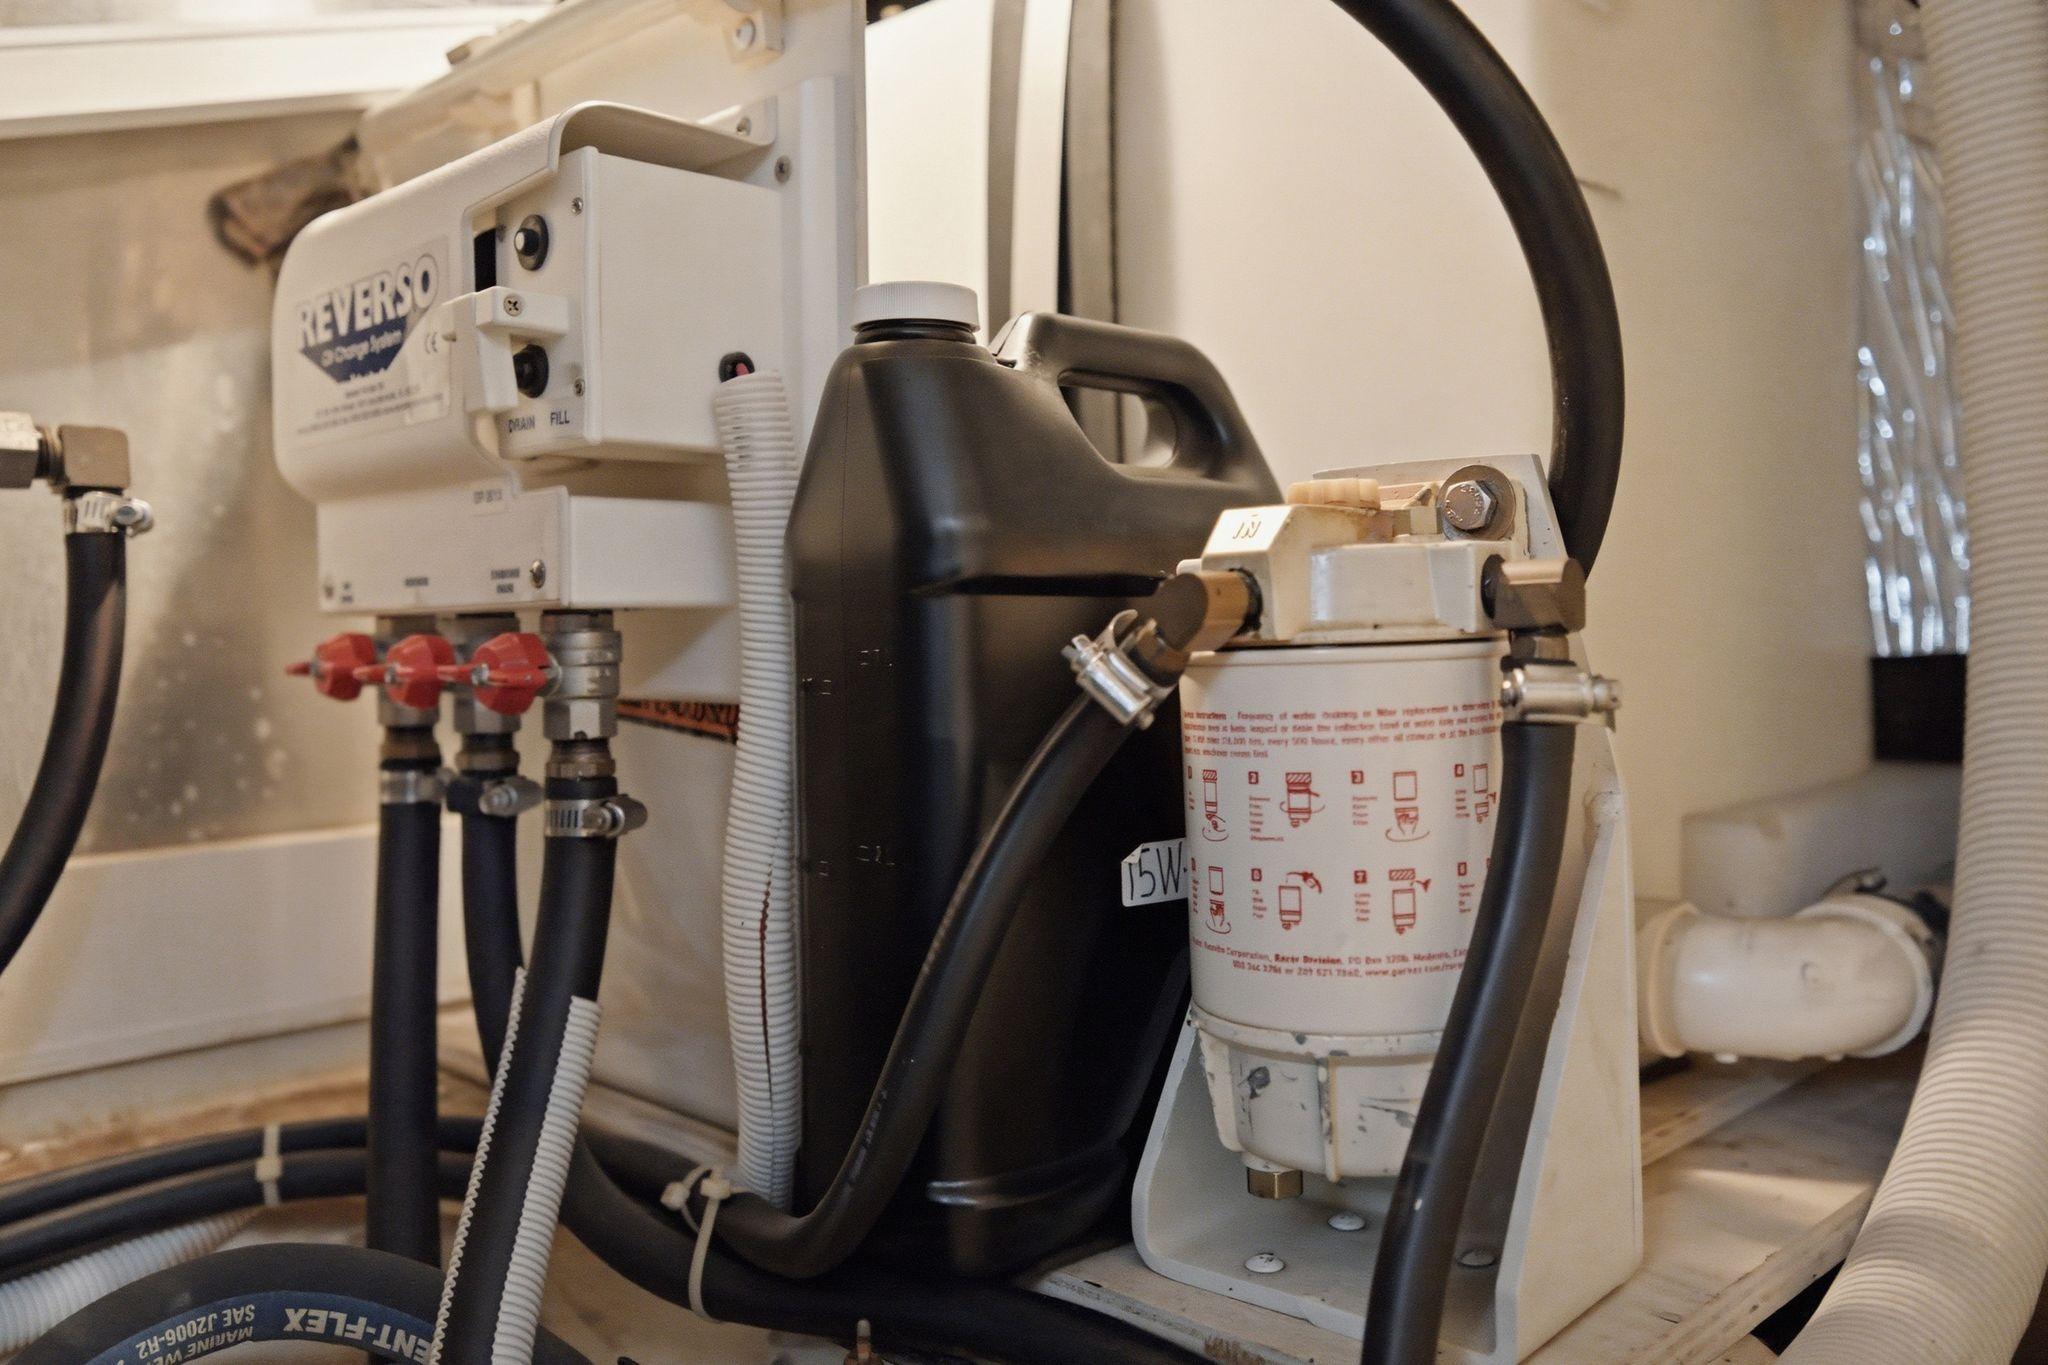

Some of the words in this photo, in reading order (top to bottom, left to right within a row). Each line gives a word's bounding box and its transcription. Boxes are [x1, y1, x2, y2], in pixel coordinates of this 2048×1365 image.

[299, 253, 439, 349] REVERSO
[508, 415, 536, 433] DRAIN
[550, 410, 570, 426] FILL
[1232, 520, 1262, 540] IN
[222, 1304, 255, 1327] SAE
[135, 1313, 218, 1360] J2006-R2
[184, 1326, 253, 1358] MARINE
[283, 1308, 433, 1365] ENT-FLEX
[147, 1346, 183, 1365] WE
